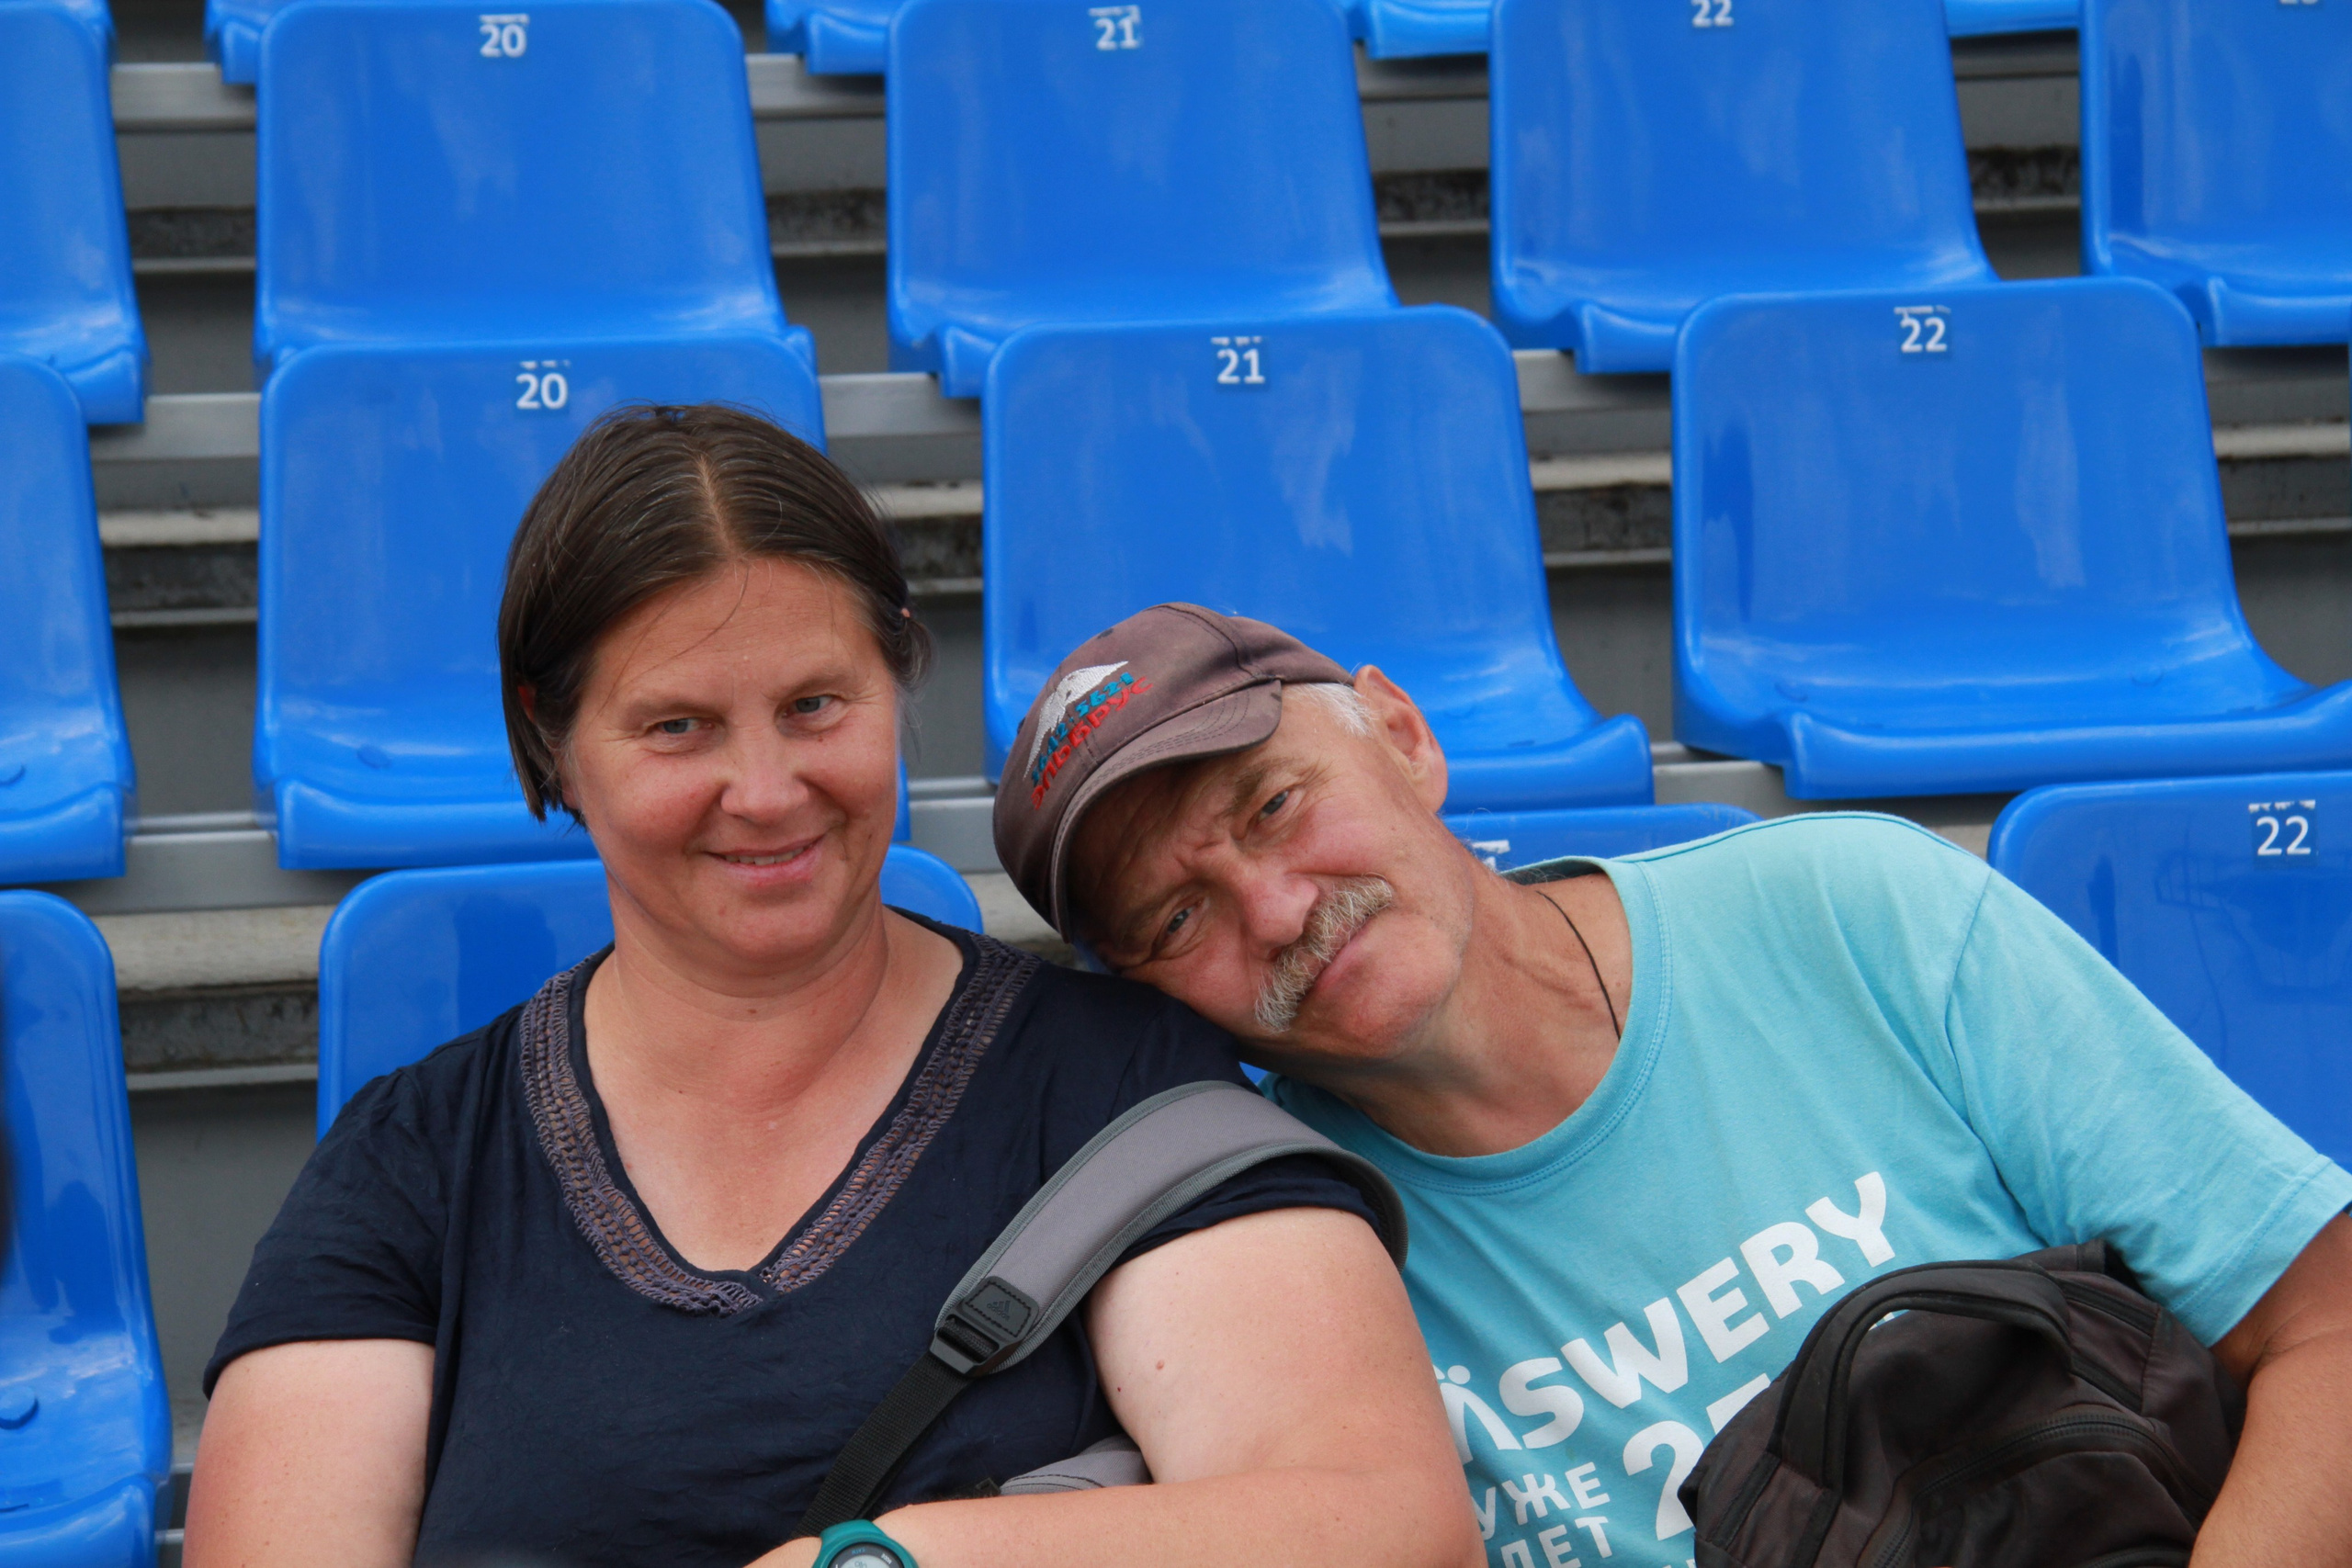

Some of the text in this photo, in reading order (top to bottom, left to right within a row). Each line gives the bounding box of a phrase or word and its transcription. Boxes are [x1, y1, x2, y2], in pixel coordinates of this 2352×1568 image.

[1690, 0, 1735, 28] 22
[479, 23, 527, 58] 20
[1094, 17, 1140, 51] 21
[1900, 317, 1948, 353] 22
[1216, 348, 1265, 384] 21
[515, 372, 568, 410] 20
[2256, 815, 2312, 855] 22
[1472, 1461, 1611, 1540] УЖЕ
